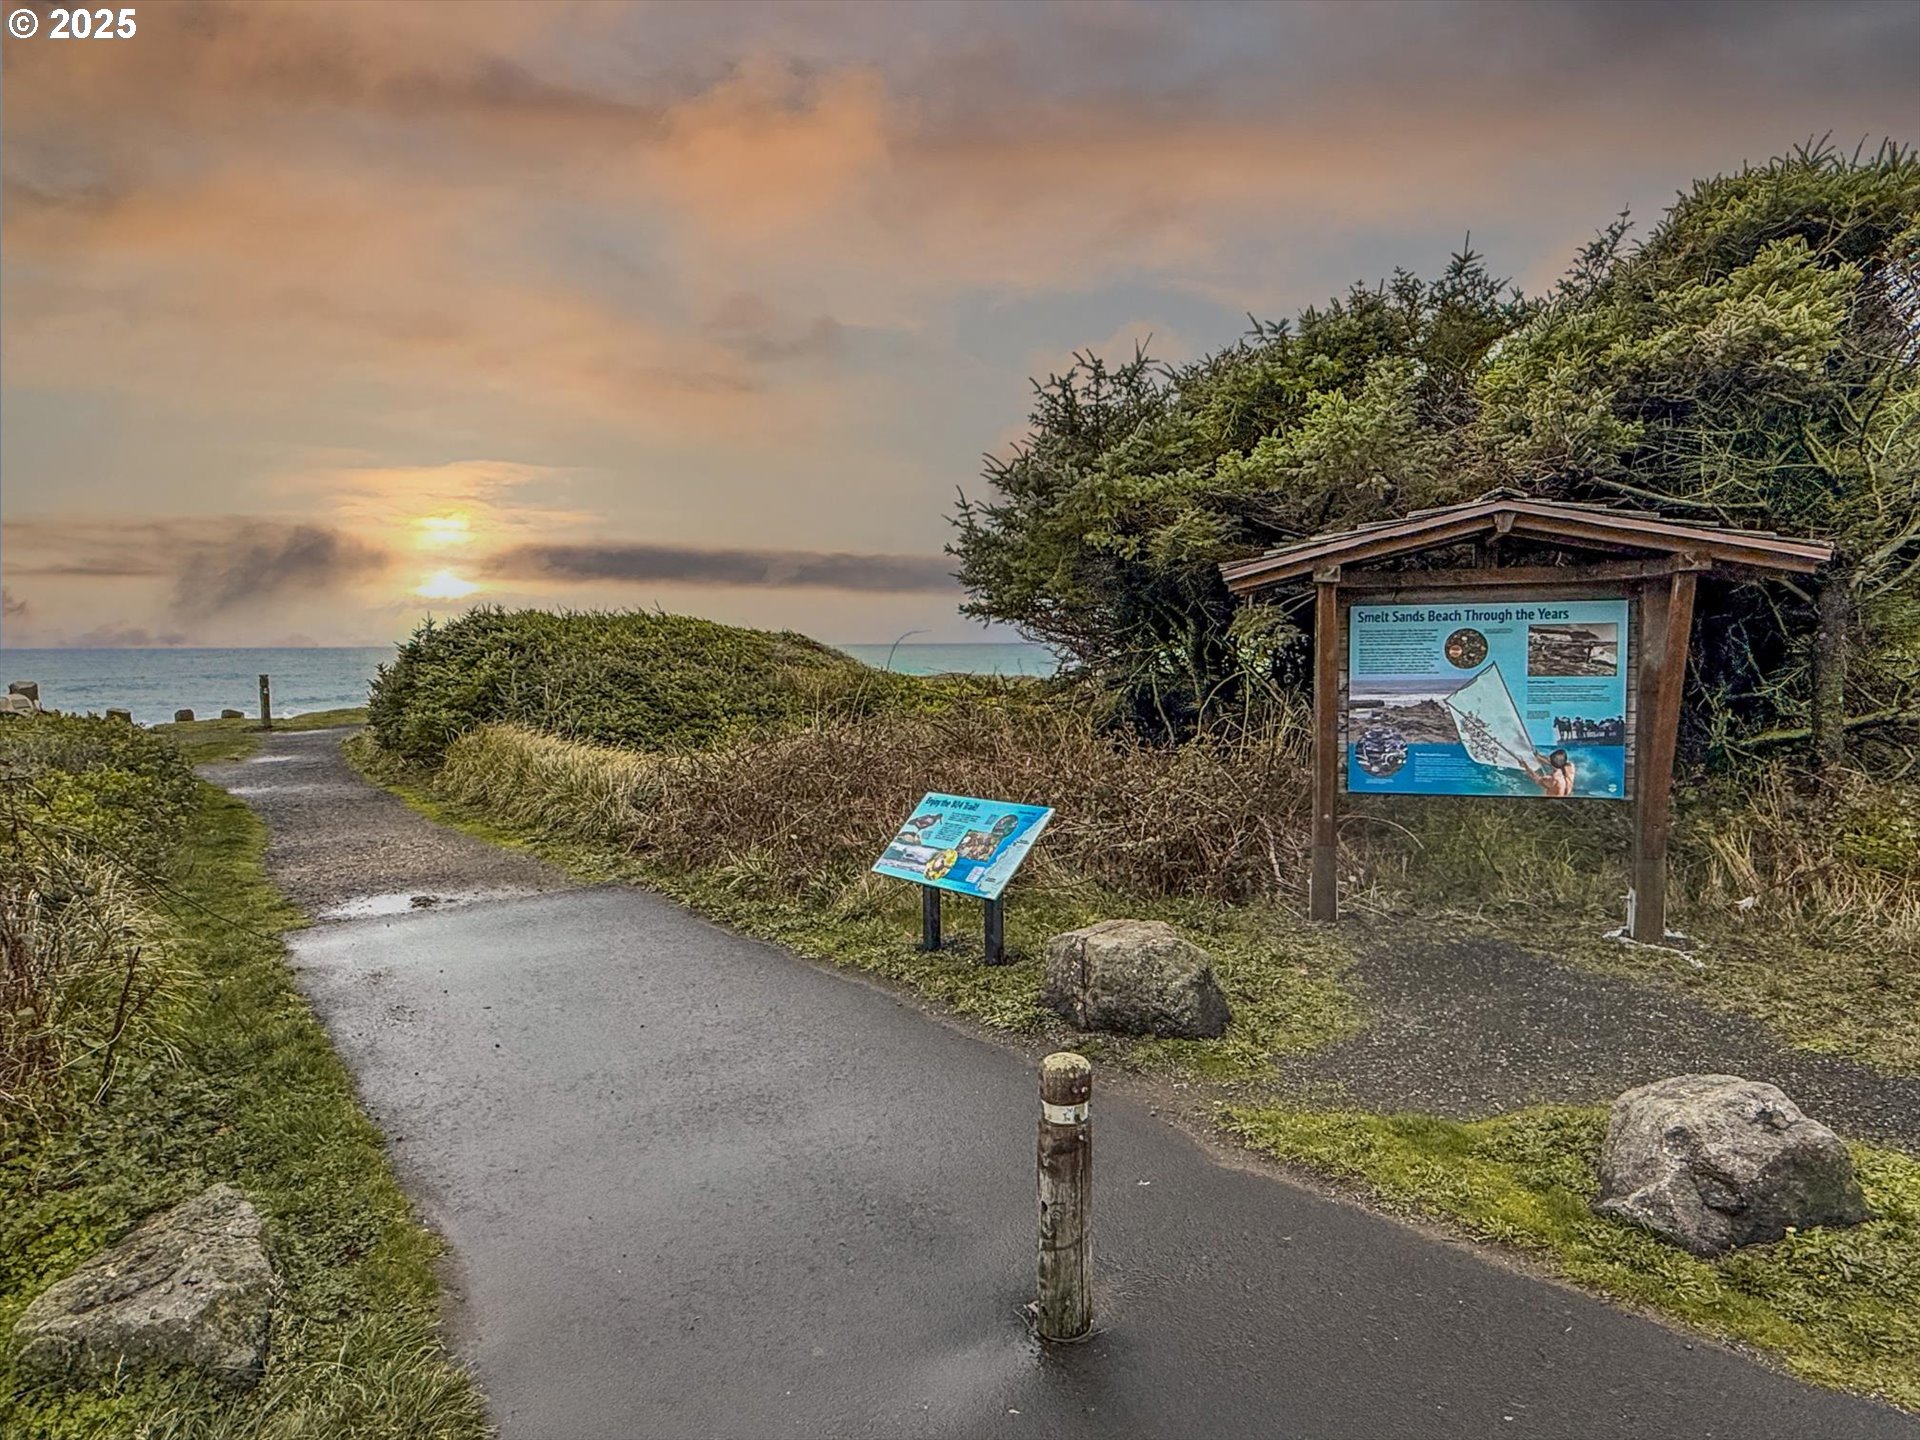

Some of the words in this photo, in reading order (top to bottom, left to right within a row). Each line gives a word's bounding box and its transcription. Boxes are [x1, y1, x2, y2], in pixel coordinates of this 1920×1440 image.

[1357, 611, 1390, 623] Smelt
[1392, 610, 1425, 623] Sands
[1428, 609, 1461, 622] Beach
[1464, 608, 1512, 624] Through
[1515, 608, 1535, 620] the
[1537, 608, 1570, 620] Years
